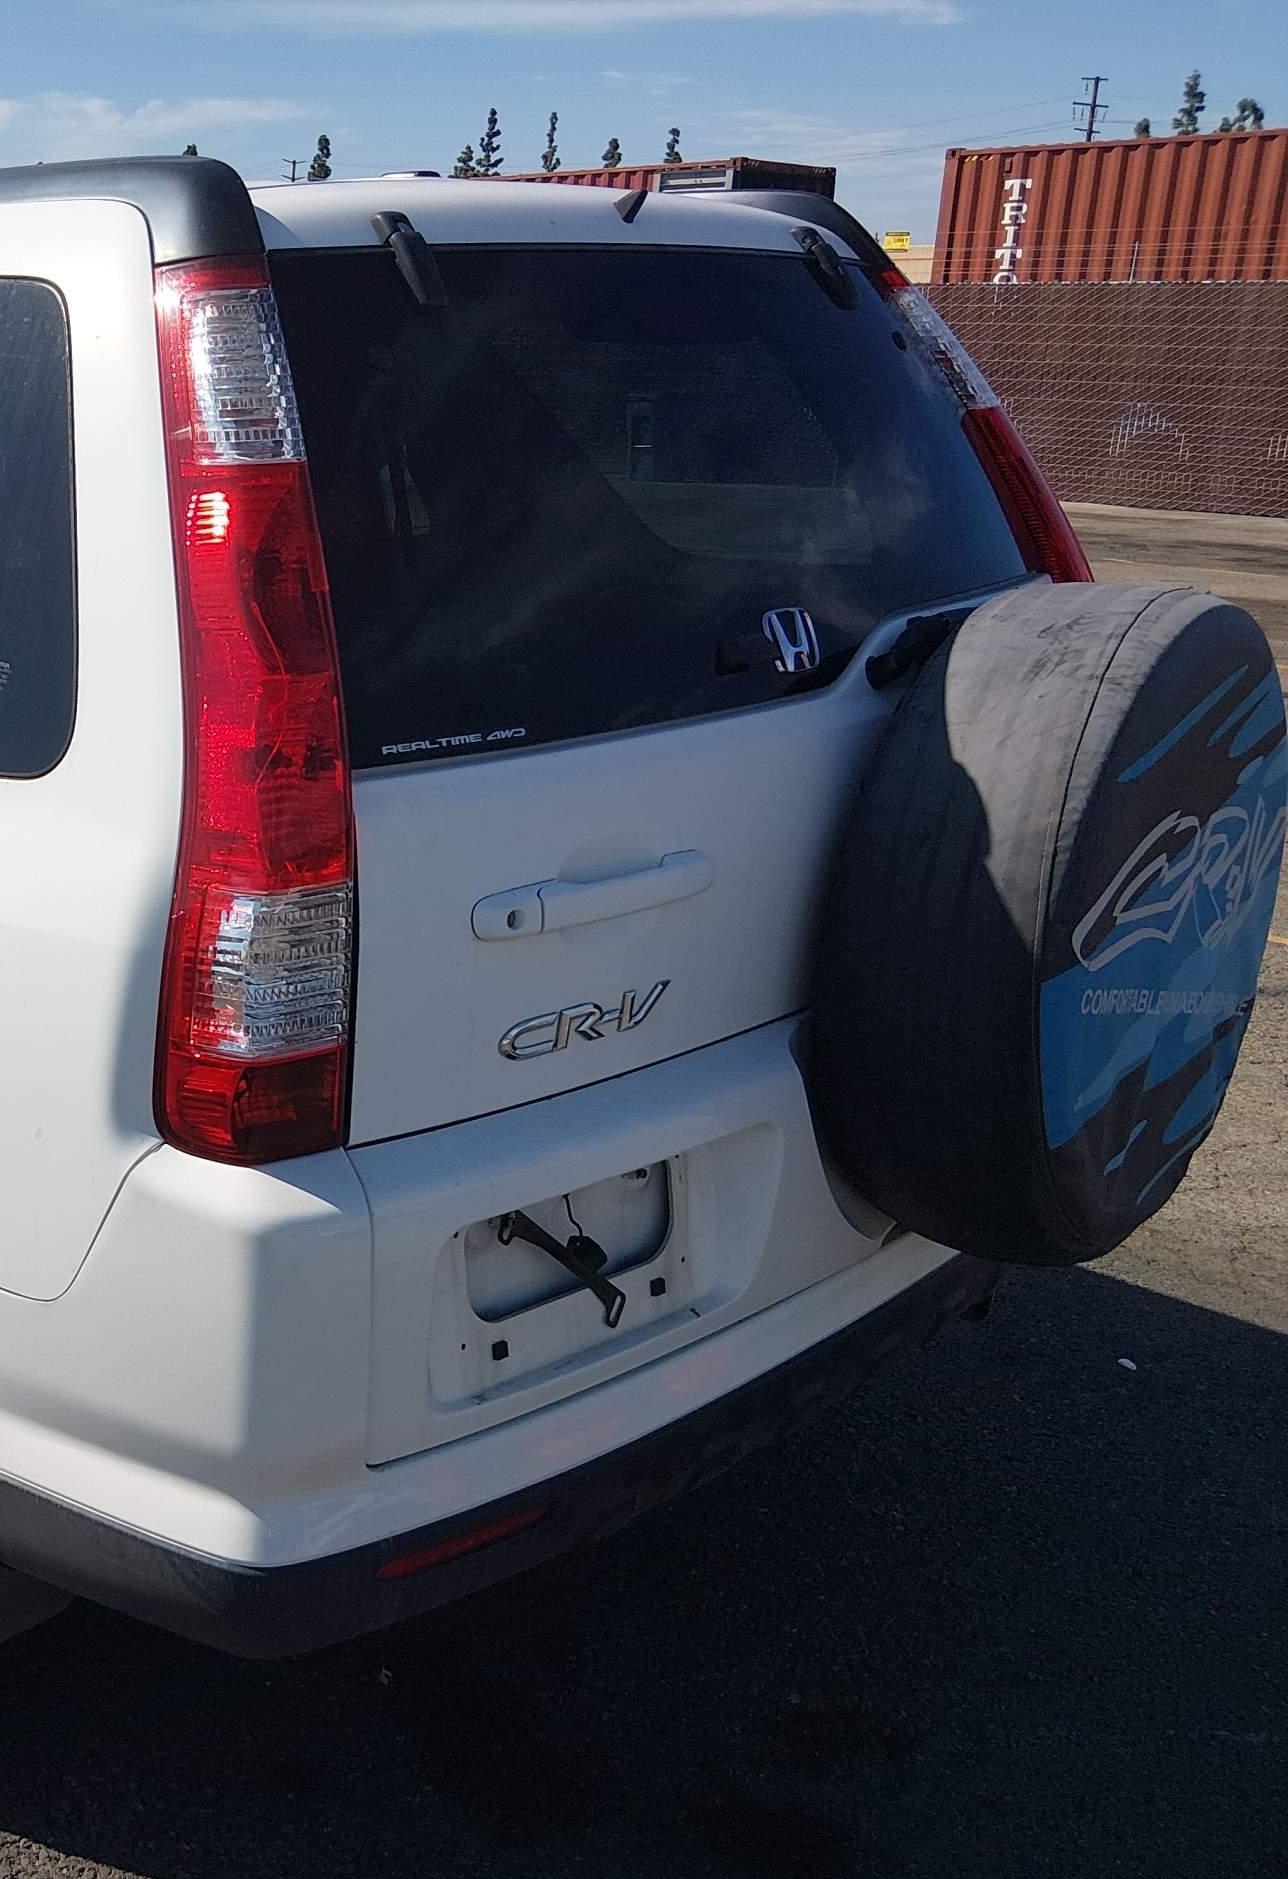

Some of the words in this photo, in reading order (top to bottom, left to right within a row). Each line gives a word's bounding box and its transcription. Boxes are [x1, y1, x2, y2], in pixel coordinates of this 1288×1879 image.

[486, 728, 526, 741] 4WD
[1080, 989, 1163, 1015] COMFORTABLE
[498, 979, 671, 1061] CR-V
